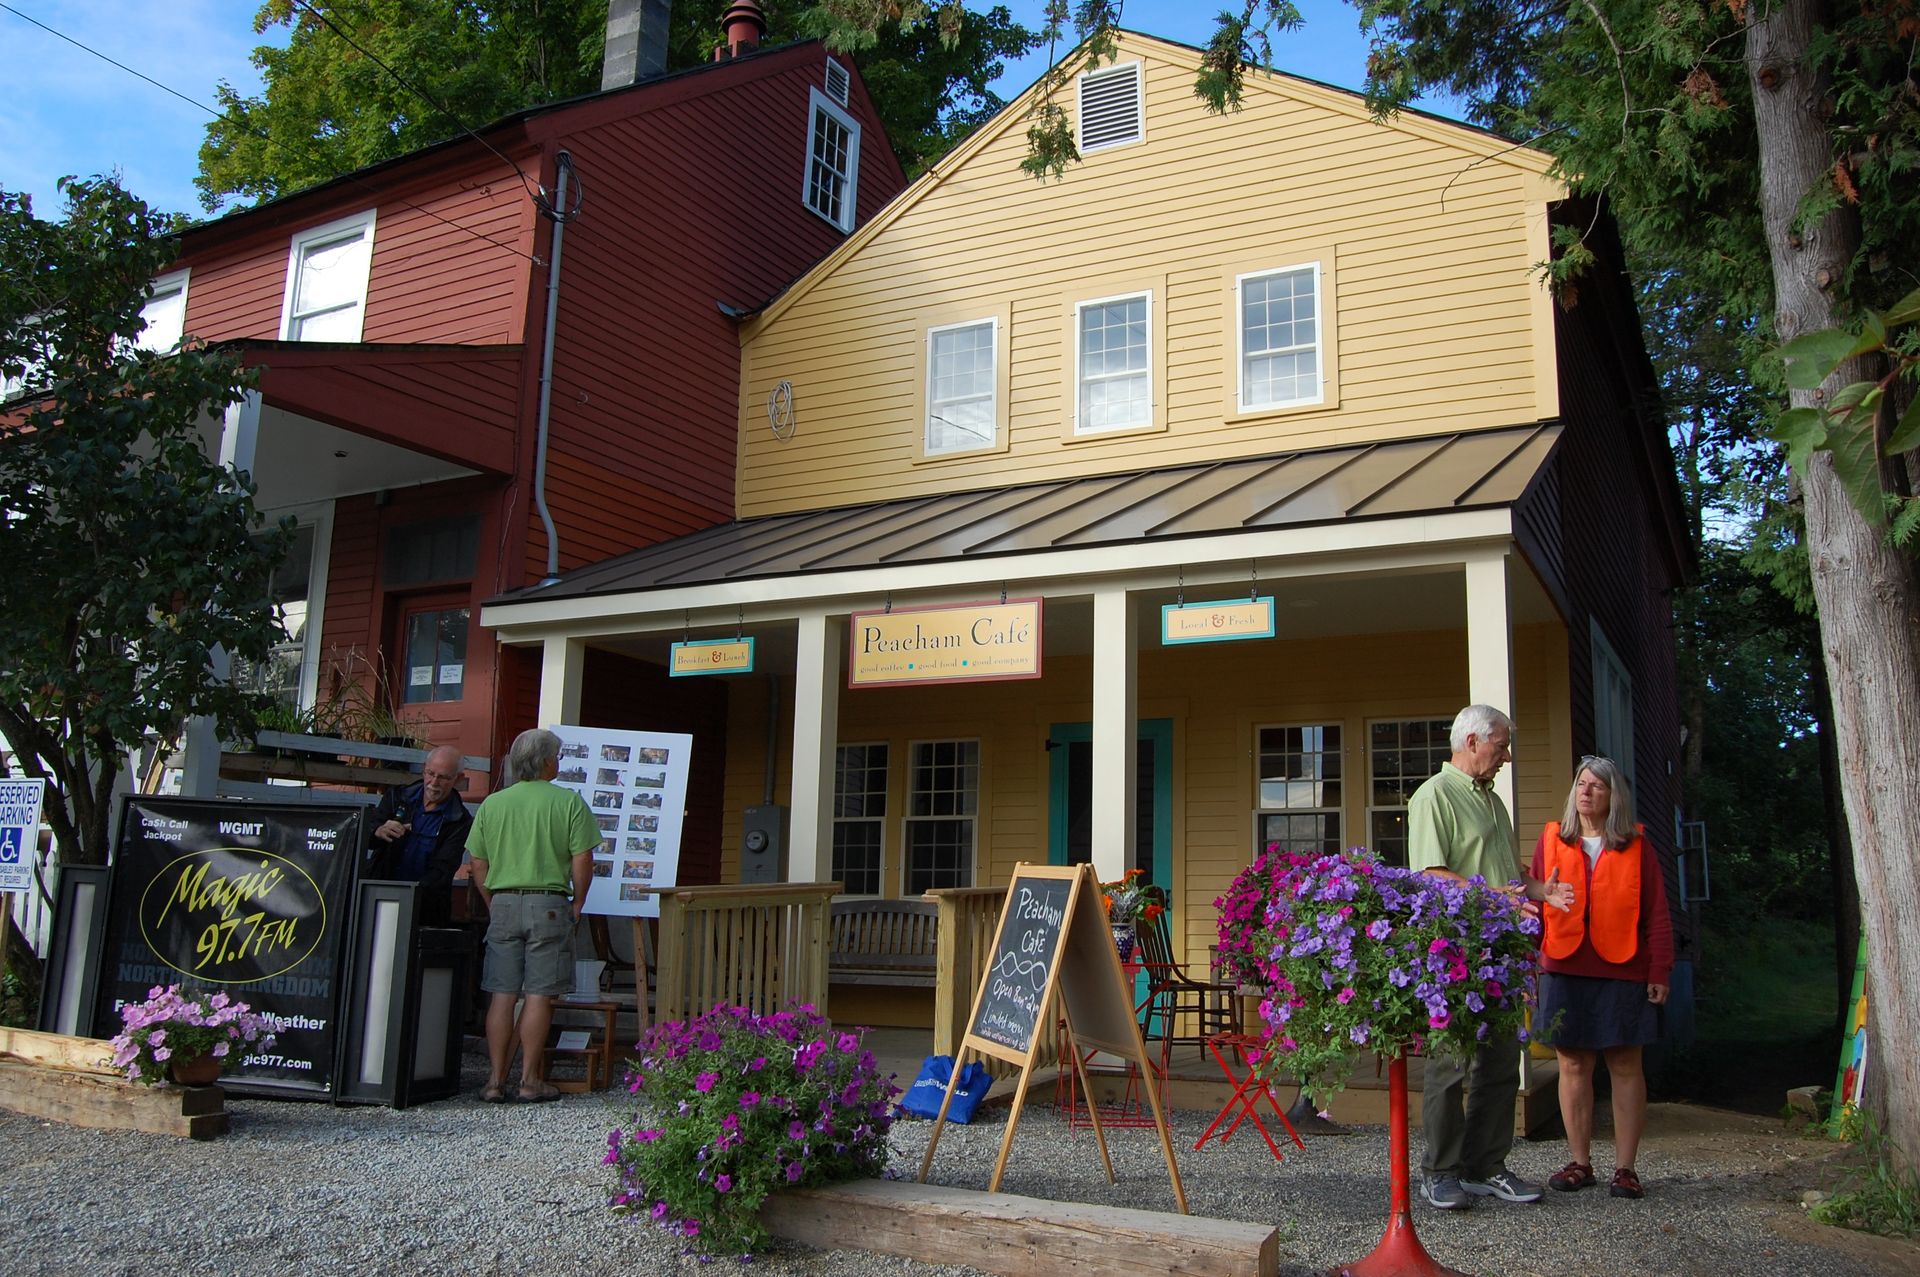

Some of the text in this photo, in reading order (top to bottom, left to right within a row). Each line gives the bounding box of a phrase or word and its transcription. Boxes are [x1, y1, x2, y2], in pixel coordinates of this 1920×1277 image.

[1181, 614, 1255, 630] Local & Fresh
[863, 617, 1029, 654] Peacham Café
[677, 650, 746, 665] Breakfast & Lunch
[918, 659, 958, 670] good food
[972, 656, 1029, 667] good company
[860, 663, 905, 674] good coffee
[0, 785, 40, 805] ESERVED
[0, 806, 33, 825] ARKING
[168, 819, 188, 830] Call
[219, 821, 263, 836] WGMT
[144, 830, 183, 842] Jackpot
[308, 828, 337, 840] Magic
[307, 840, 335, 851] Trivia
[157, 859, 284, 929] Magic
[1016, 887, 1062, 930] Peacham
[993, 978, 1013, 1001] Open
[261, 1011, 327, 1031] Weather
